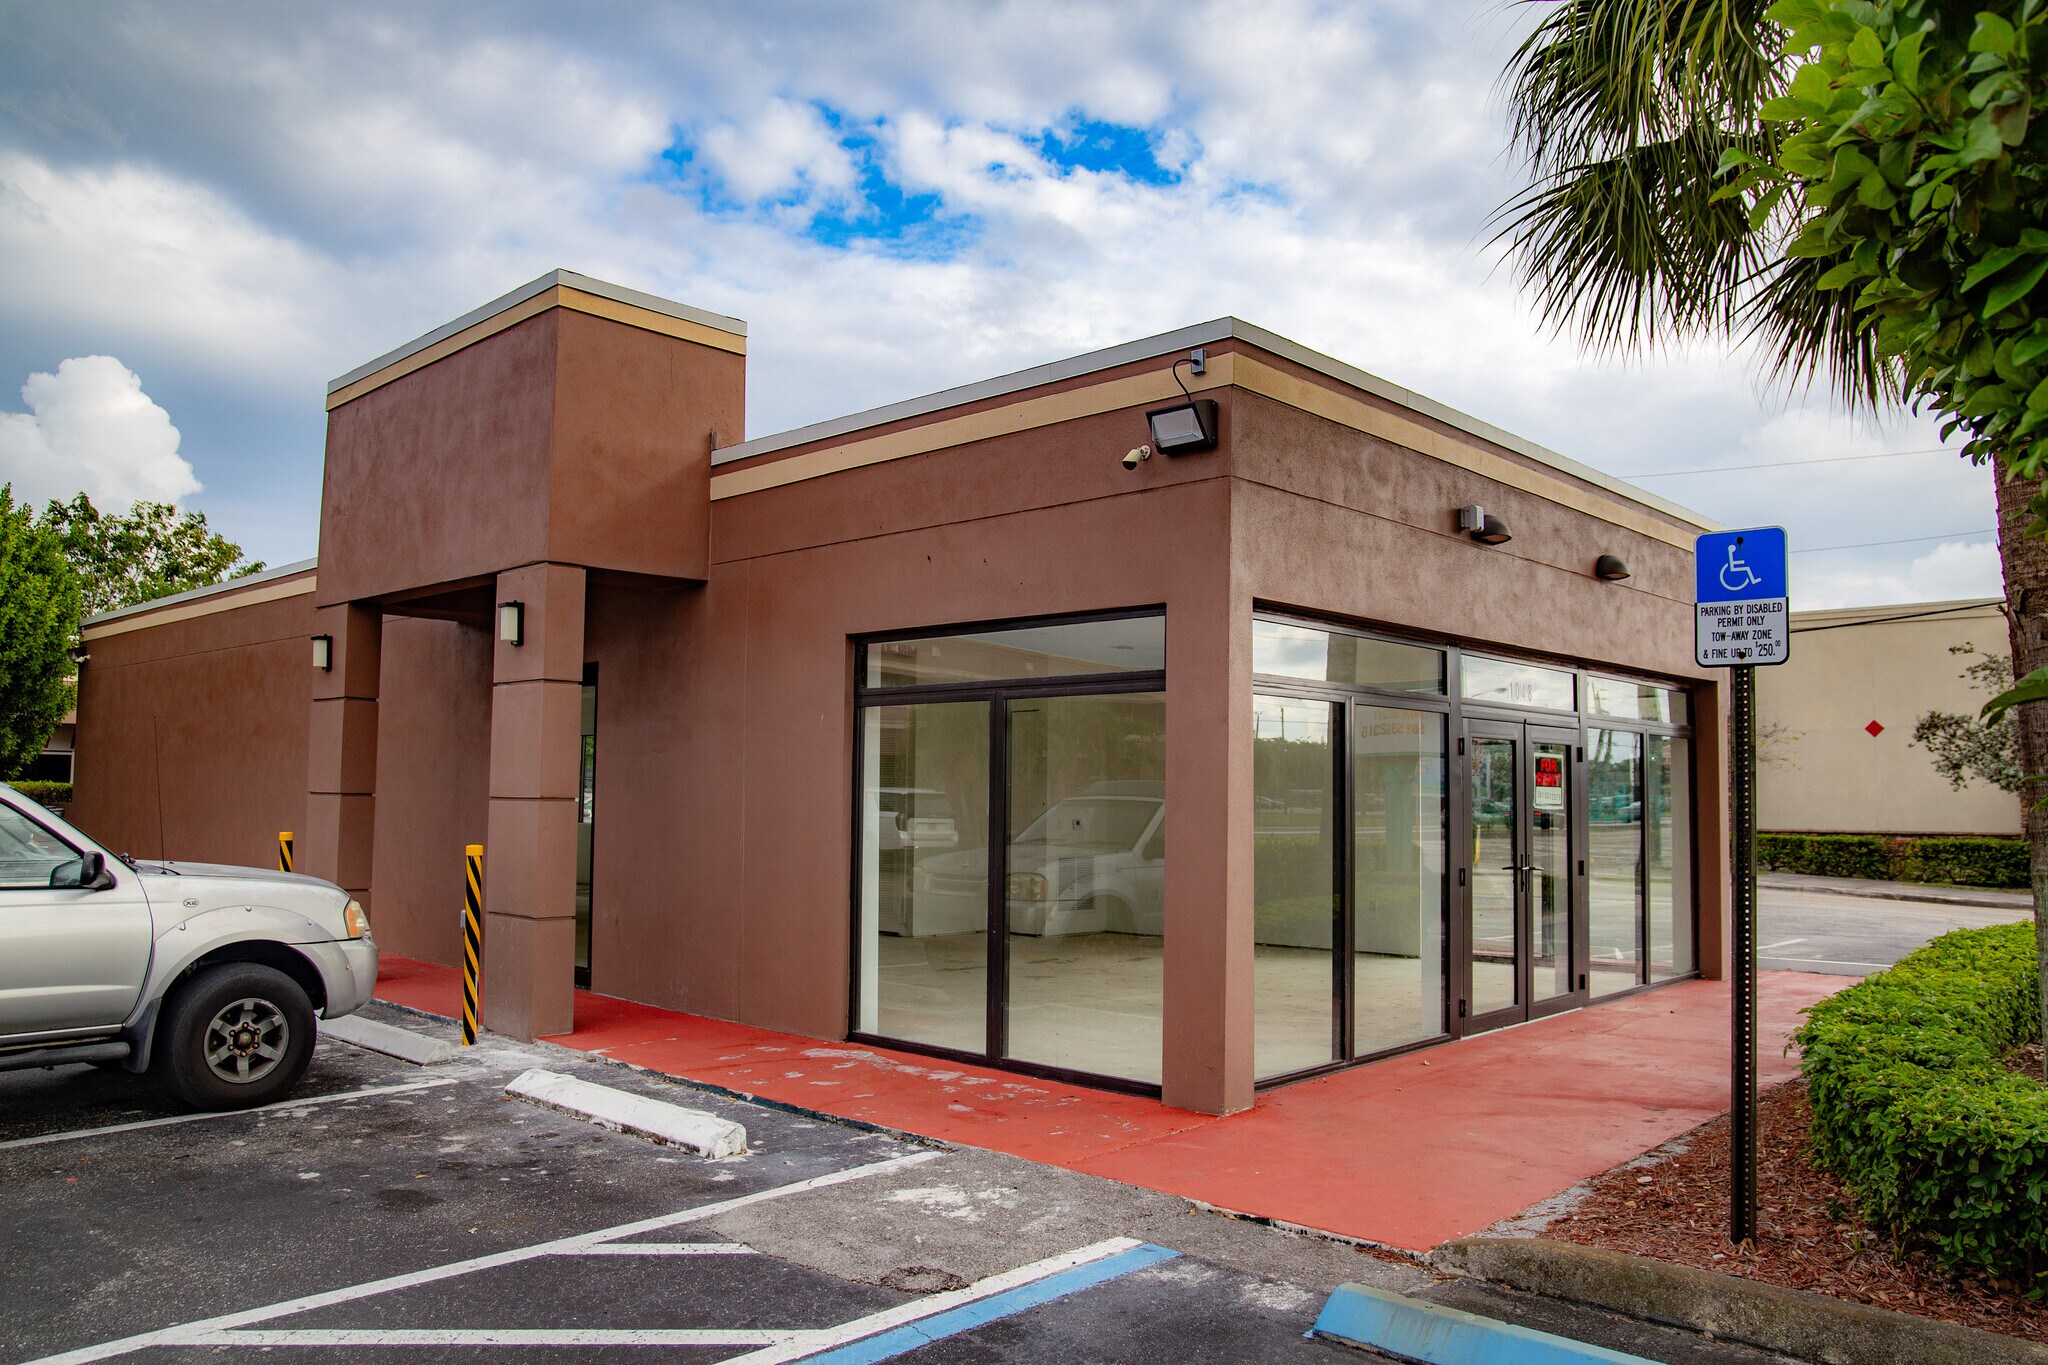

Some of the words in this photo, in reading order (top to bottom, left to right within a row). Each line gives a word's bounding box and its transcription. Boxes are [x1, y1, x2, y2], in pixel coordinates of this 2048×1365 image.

[1700, 605, 1731, 617] PARKING
[1734, 604, 1744, 615] BY
[1747, 602, 1782, 614] DISABLED
[1717, 616, 1744, 628] PERMIT
[1747, 615, 1765, 626] ONLY
[1711, 630, 1749, 642] TOW-AWAY
[1752, 629, 1772, 640] ZONE
[1703, 649, 1709, 659] &
[1711, 648, 1728, 659] FINE
[1743, 647, 1753, 658] TO
[1509, 681, 1533, 702] 1048
[1540, 758, 1557, 772] FOR
[1536, 772, 1561, 787] RENT
